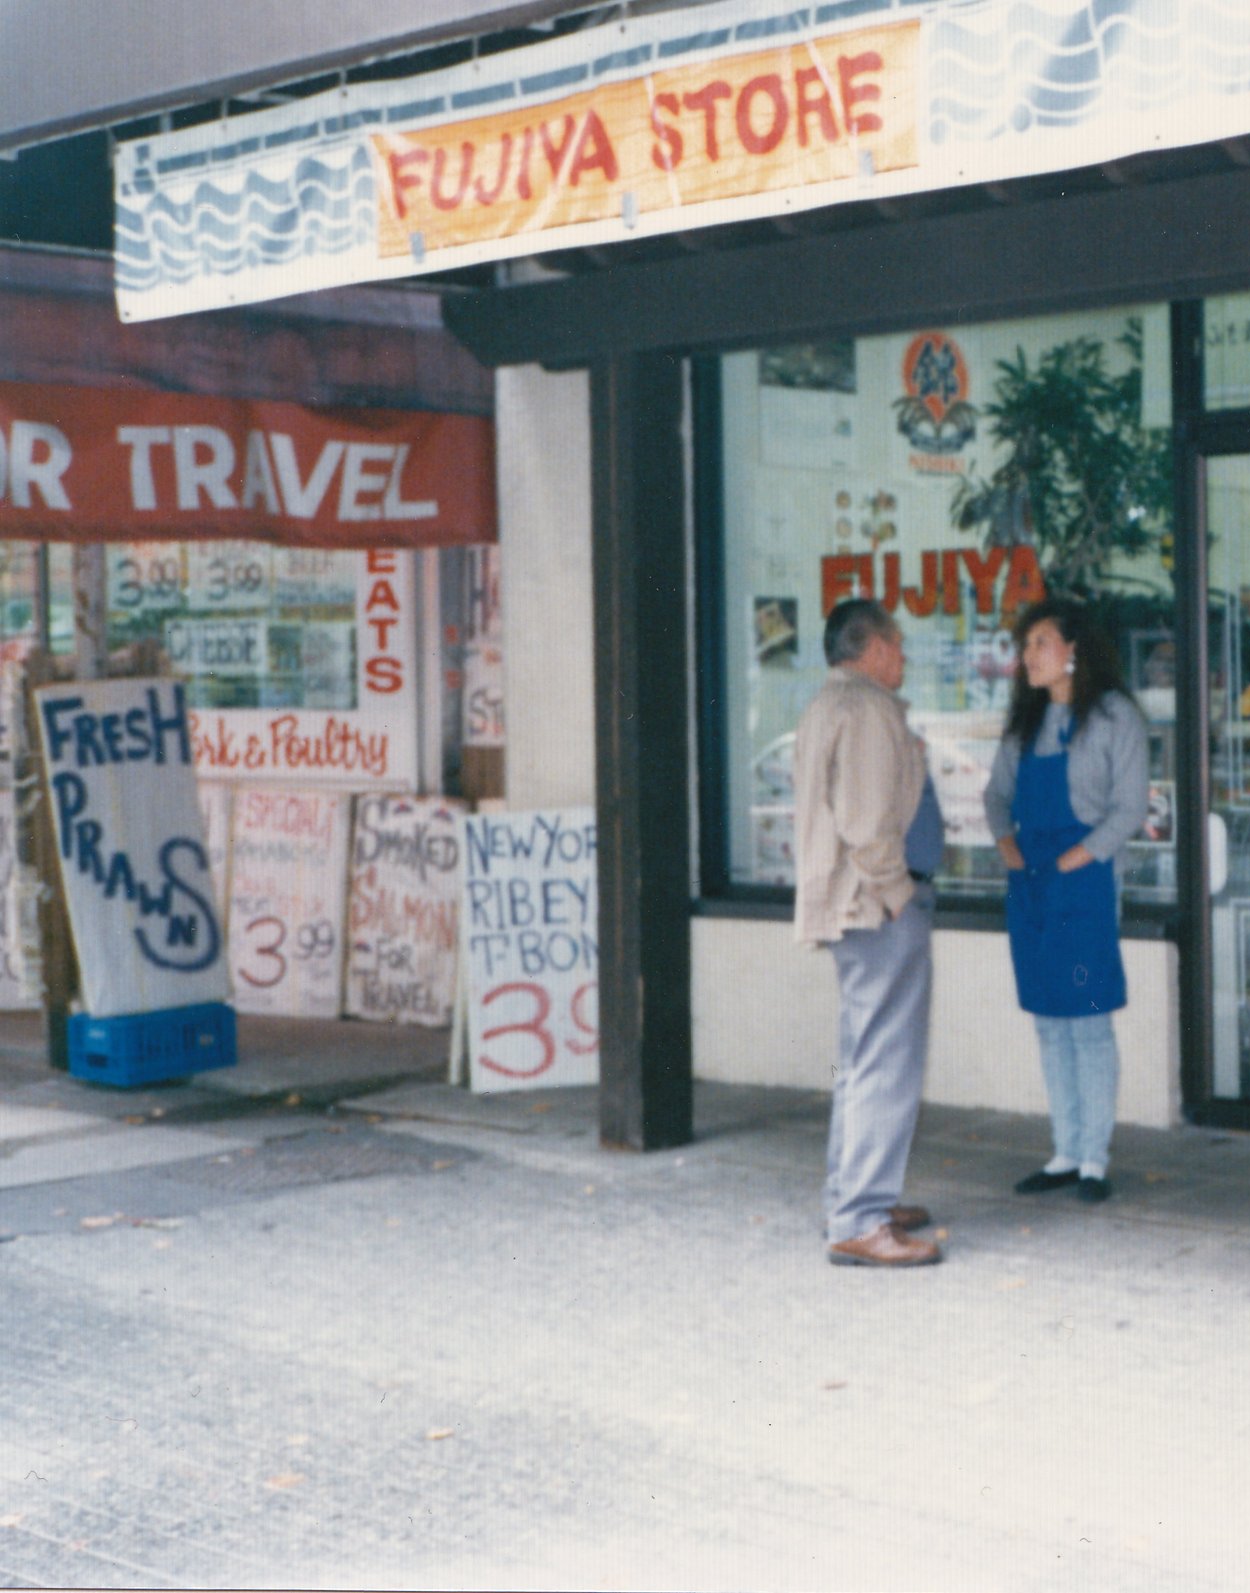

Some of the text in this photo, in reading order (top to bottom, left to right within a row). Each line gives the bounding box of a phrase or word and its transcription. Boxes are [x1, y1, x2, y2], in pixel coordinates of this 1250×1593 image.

[388, 50, 885, 219] FUJIYA STORE
[0, 419, 438, 522] R TRAVEL
[821, 544, 1046, 622] FUJIYA
[42, 683, 192, 767] FRESH
[269, 715, 388, 777] Poultry
